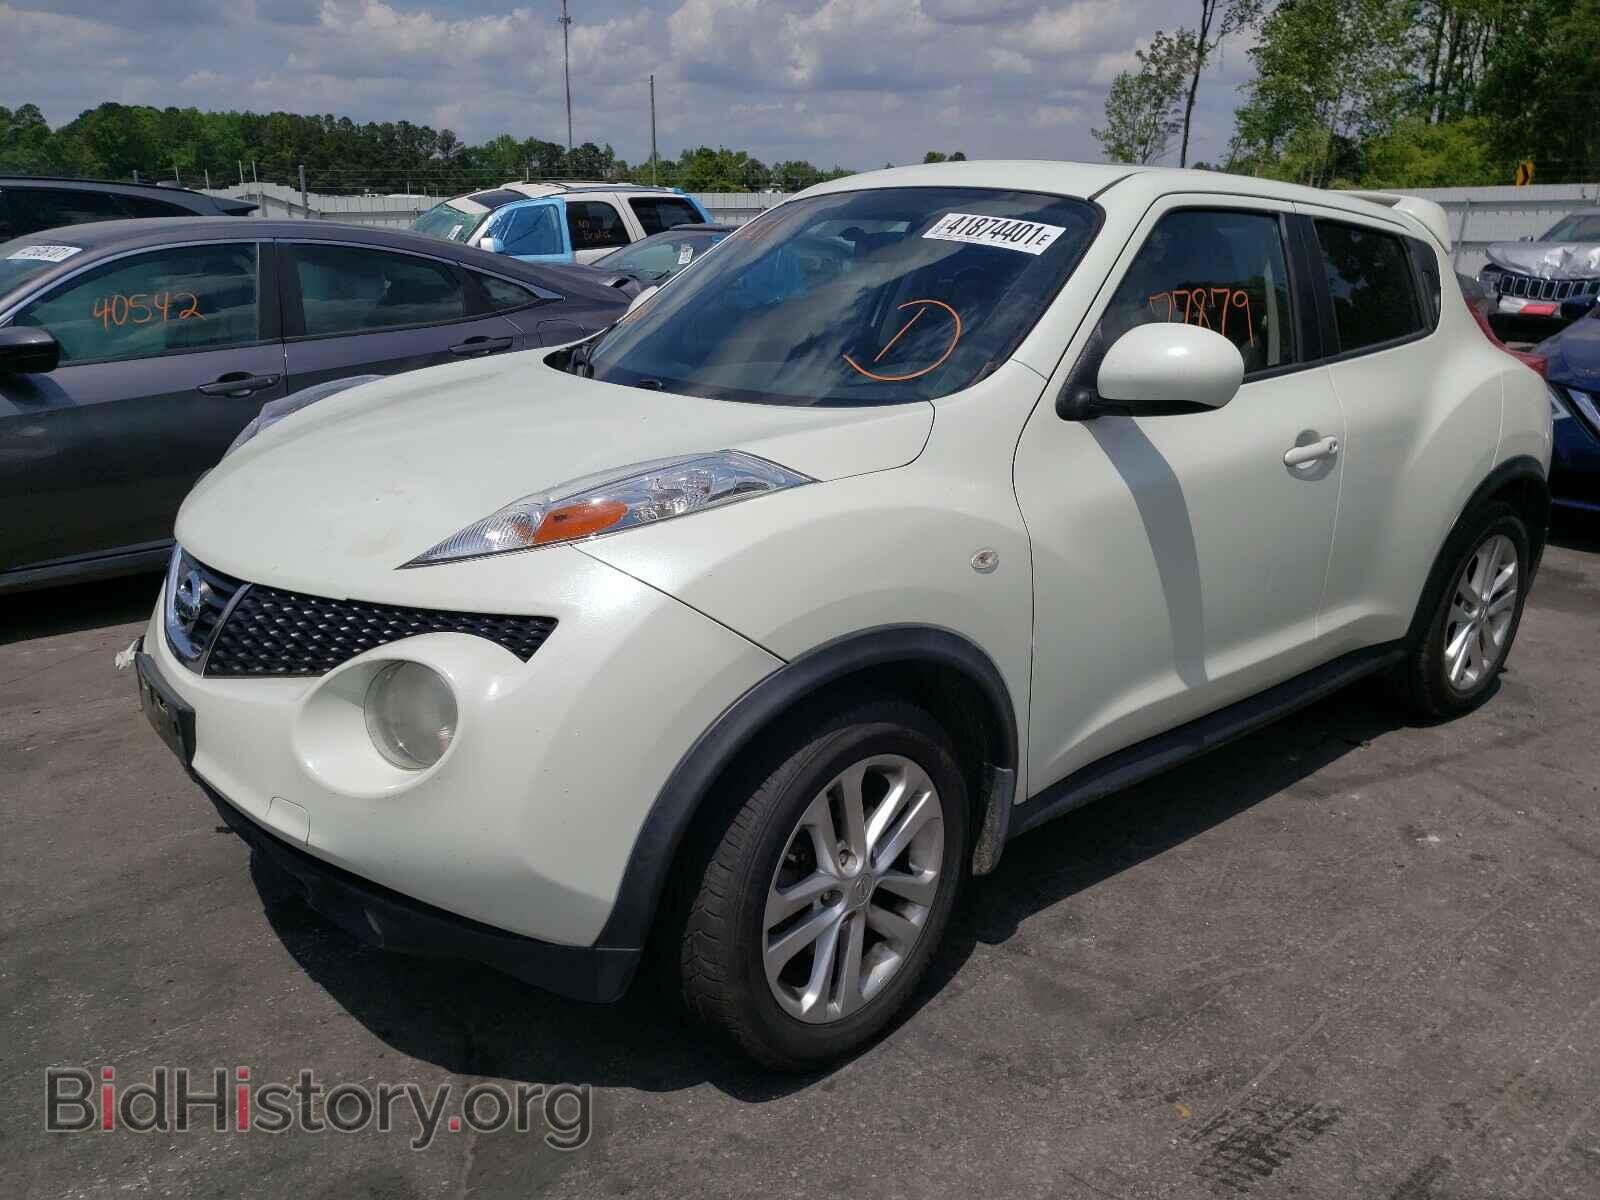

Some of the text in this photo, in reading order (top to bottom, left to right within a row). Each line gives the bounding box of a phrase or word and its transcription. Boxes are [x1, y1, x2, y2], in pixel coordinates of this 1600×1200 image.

[946, 216, 1045, 245] 41874401
[1036, 234, 1051, 246] E
[92, 291, 207, 333] 40542
[1148, 287, 1254, 348] 77879
